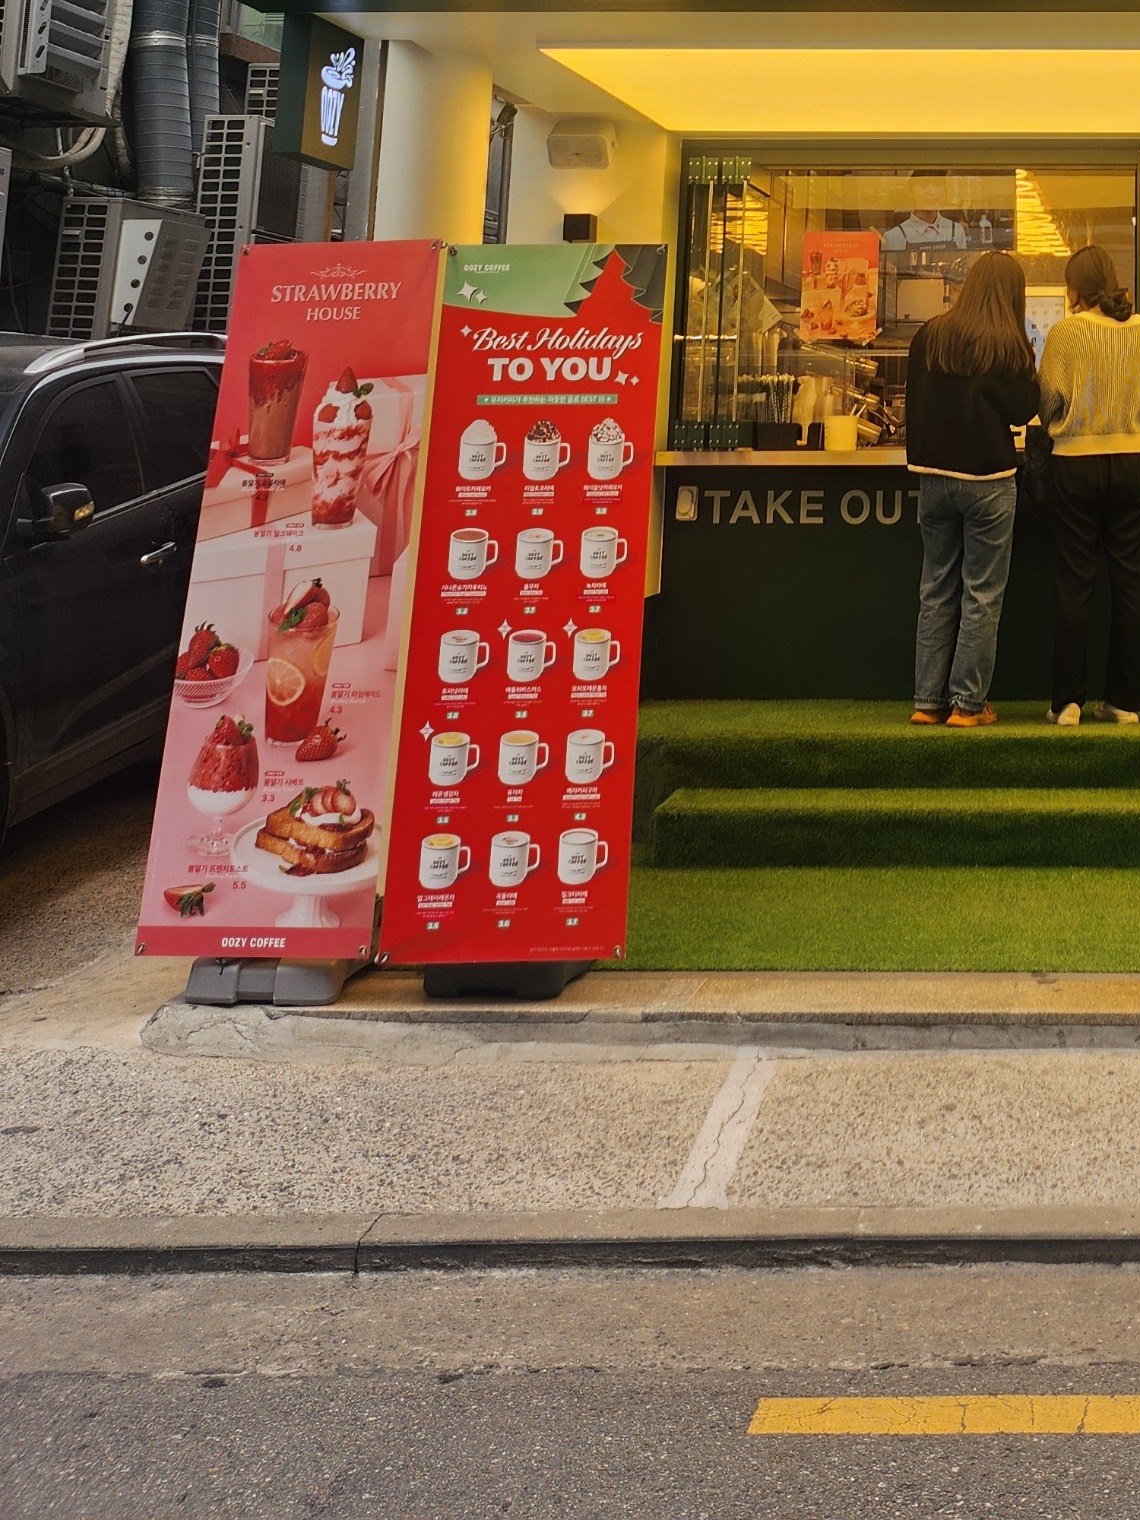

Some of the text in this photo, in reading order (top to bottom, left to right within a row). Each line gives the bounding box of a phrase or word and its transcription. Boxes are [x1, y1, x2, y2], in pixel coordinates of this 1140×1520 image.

[321, 85, 345, 137] OOZY
[463, 264, 483, 272] OOZY
[270, 281, 402, 303] STRAWBERRY
[306, 305, 362, 322] HOUSE
[472, 327, 644, 360] Best Holidays
[487, 357, 612, 382] TO YOU
[704, 490, 825, 525] TAKE
[232, 881, 247, 889] 5.5
[221, 937, 287, 948] OOZY COFFEE
